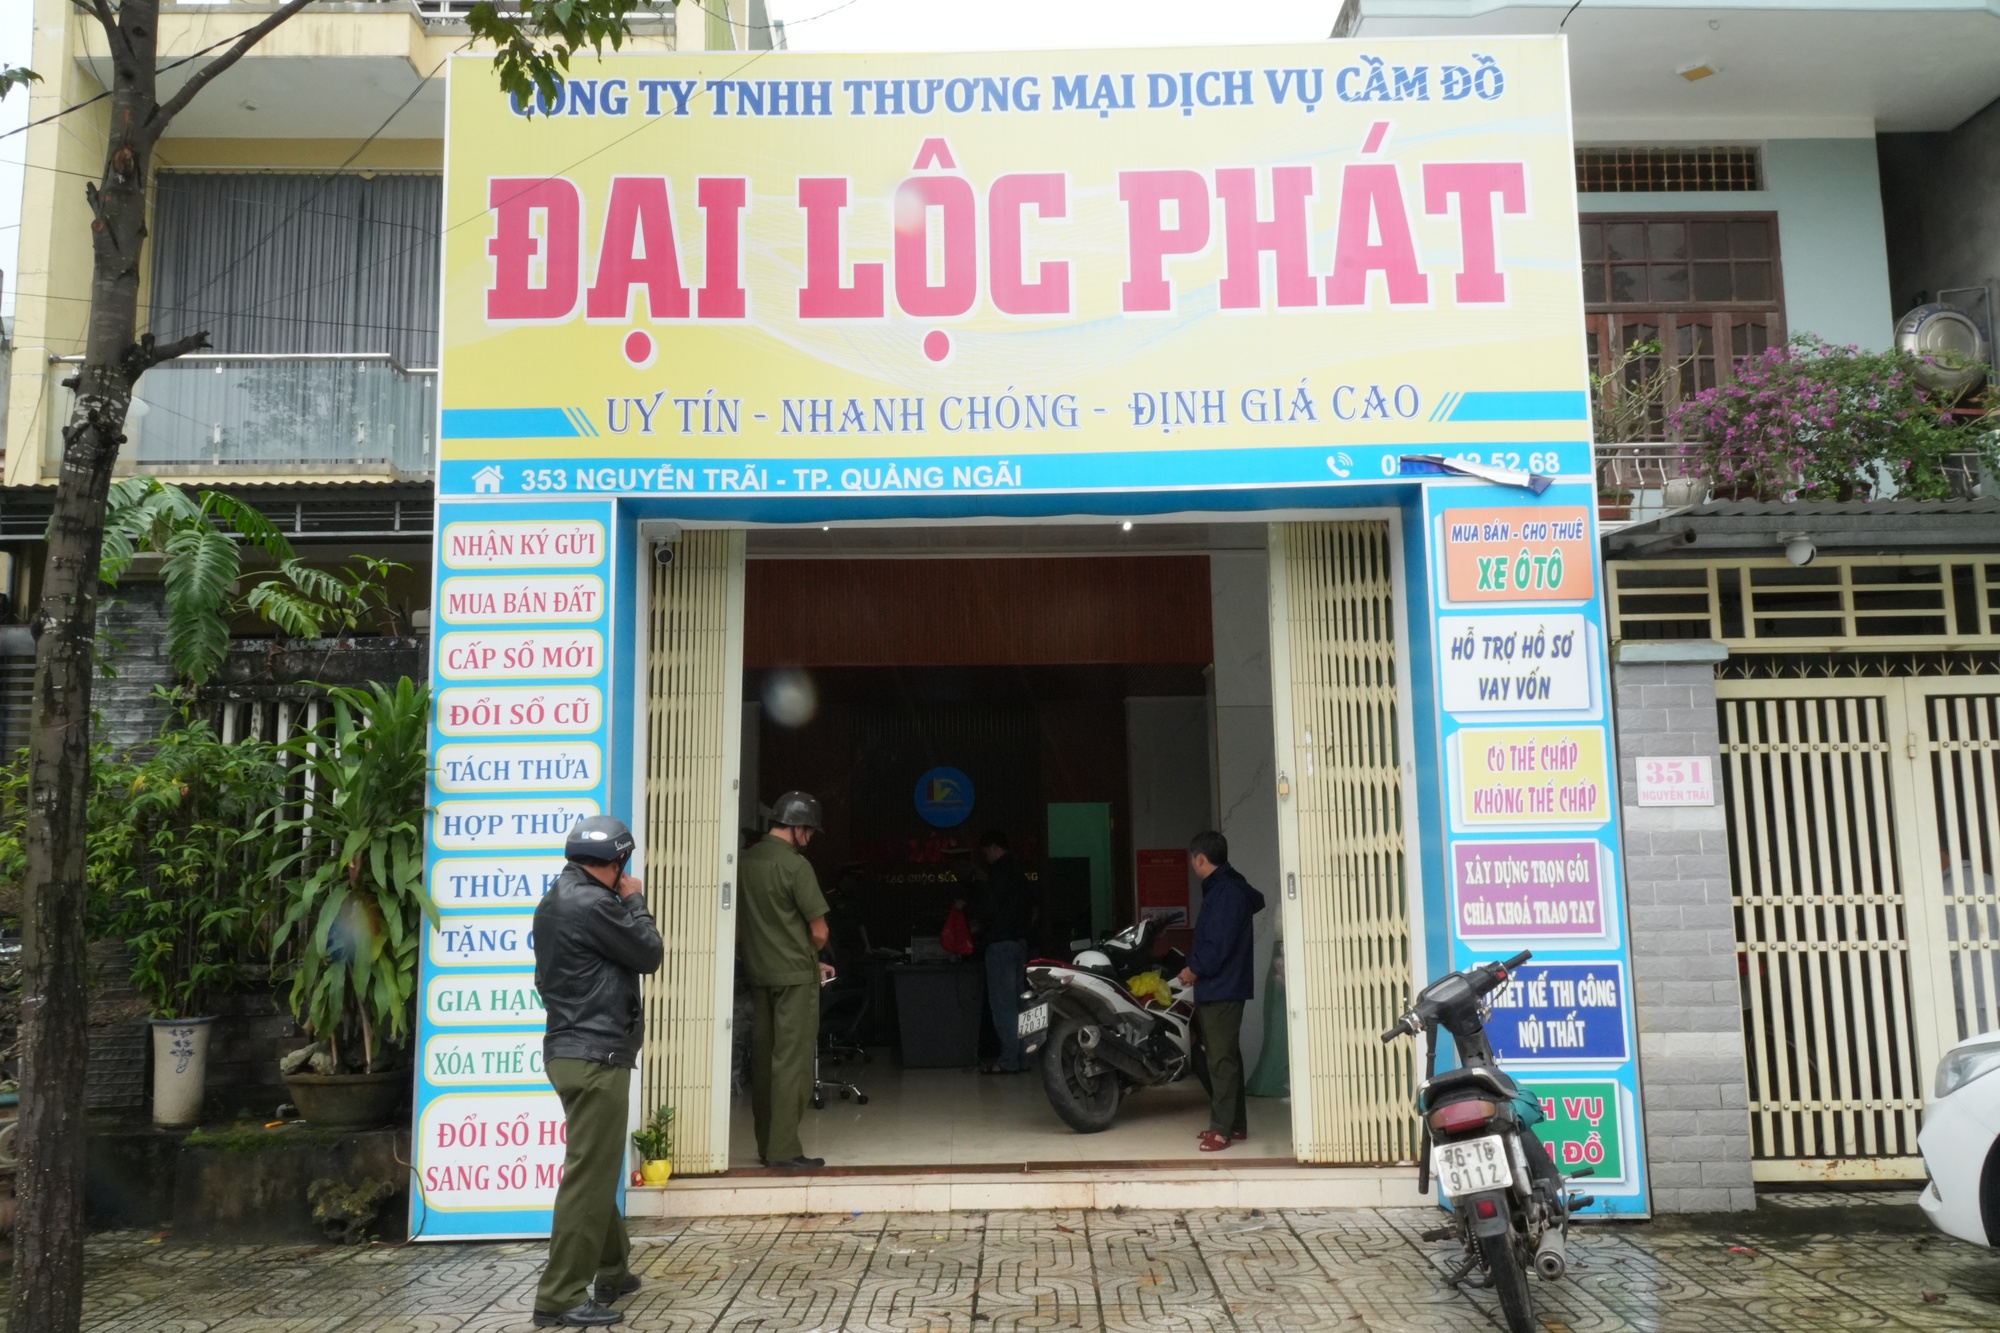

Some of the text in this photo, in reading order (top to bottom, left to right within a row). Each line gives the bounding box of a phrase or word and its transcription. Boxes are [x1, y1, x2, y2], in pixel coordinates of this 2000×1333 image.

[639, 79, 696, 117] TY
[706, 80, 833, 117] TNHH
[843, 75, 1040, 115] THƯƠNG
[1052, 73, 1135, 118] MẠI
[1147, 70, 1254, 117] DỊCH
[1265, 68, 1324, 113] VỤ
[1336, 54, 1430, 102] CẦM
[1440, 53, 1505, 101] ĐỒ
[487, 121, 1527, 364] ĐẠI LỘC PHÁT
[675, 389, 742, 434] TÍN
[780, 397, 926, 434] NHANH
[939, 385, 1080, 433] CHÓNG
[1128, 389, 1226, 433] ĐỊNH
[1241, 377, 1318, 423] GIÁ
[1332, 384, 1420, 421] CAO
[521, 469, 567, 491] 353
[576, 463, 694, 491] NGUYỄN
[703, 465, 768, 490] TRÃI
[840, 463, 944, 490] QUẢNG
[953, 460, 1022, 488] NGÃI
[452, 528, 595, 561] NHẬN KÝ GỬI
[1451, 523, 1479, 543] MUA
[1484, 519, 1509, 542] BÁN
[1522, 521, 1547, 540] CHO
[1552, 518, 1584, 540] THUÊ
[1477, 556, 1508, 591] XE
[449, 585, 596, 615] MUA BÁN ĐẤT
[448, 639, 594, 670] CẤP SỔ MỚI
[1451, 624, 1575, 665] HỖ TRỢ HỒ SƠ
[1479, 667, 1552, 701] VAY VỐN
[450, 696, 590, 726] ĐỔI SỔ CŨ
[447, 753, 590, 782] TÁCH THỬA
[1487, 736, 1578, 772] CÓ THẾ CHẤP
[1646, 761, 1703, 785] 351
[1474, 778, 1597, 814] KHÔNG THẾ CHẤP
[443, 814, 504, 841] HỢP
[450, 868, 533, 898] THỪA
[1465, 853, 1590, 889] XÂY DỰNG TRỌN GÓI
[1463, 896, 1596, 926] CHÌA KHOÁ TRAO TAY
[441, 924, 518, 958] TẶNG
[437, 990, 482, 1012] GIA
[1527, 970, 1549, 1008] KẾ
[1550, 980, 1576, 1008] THI
[1577, 972, 1617, 1008] CÔNG
[1518, 1010, 1586, 1054] NỘI THẤT
[433, 1046, 475, 1075] XÓA
[481, 1043, 526, 1074] THẾ
[1563, 1097, 1603, 1125] VỤ
[437, 1113, 488, 1148] ĐỔI
[495, 1112, 530, 1147] SỔ
[1563, 1132, 1604, 1164] ĐỒ
[425, 1164, 490, 1192] SANG
[497, 1155, 528, 1190] SỔ
[1450, 1164, 1501, 1191] 9112
